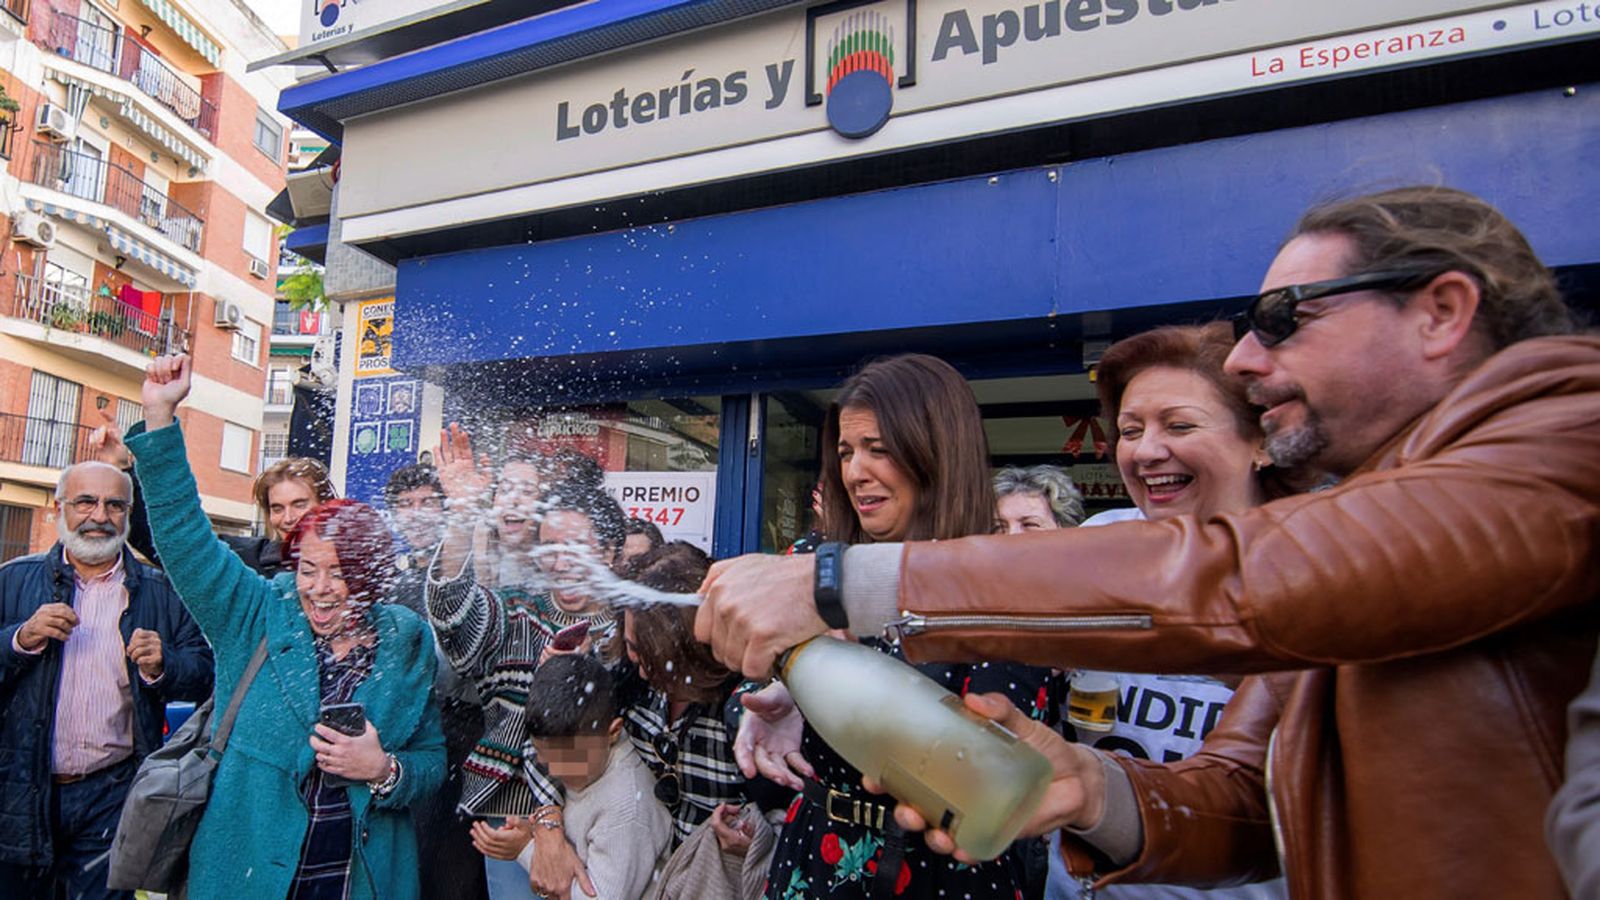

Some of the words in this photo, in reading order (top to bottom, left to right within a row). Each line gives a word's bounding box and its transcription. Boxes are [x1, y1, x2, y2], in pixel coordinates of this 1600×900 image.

[556, 68, 748, 141] Loterías
[765, 59, 795, 109] y
[931, 0, 1236, 65] Apues
[1251, 56, 1285, 77] La
[1299, 26, 1466, 70] Esperanza
[622, 486, 701, 503] PREMIO
